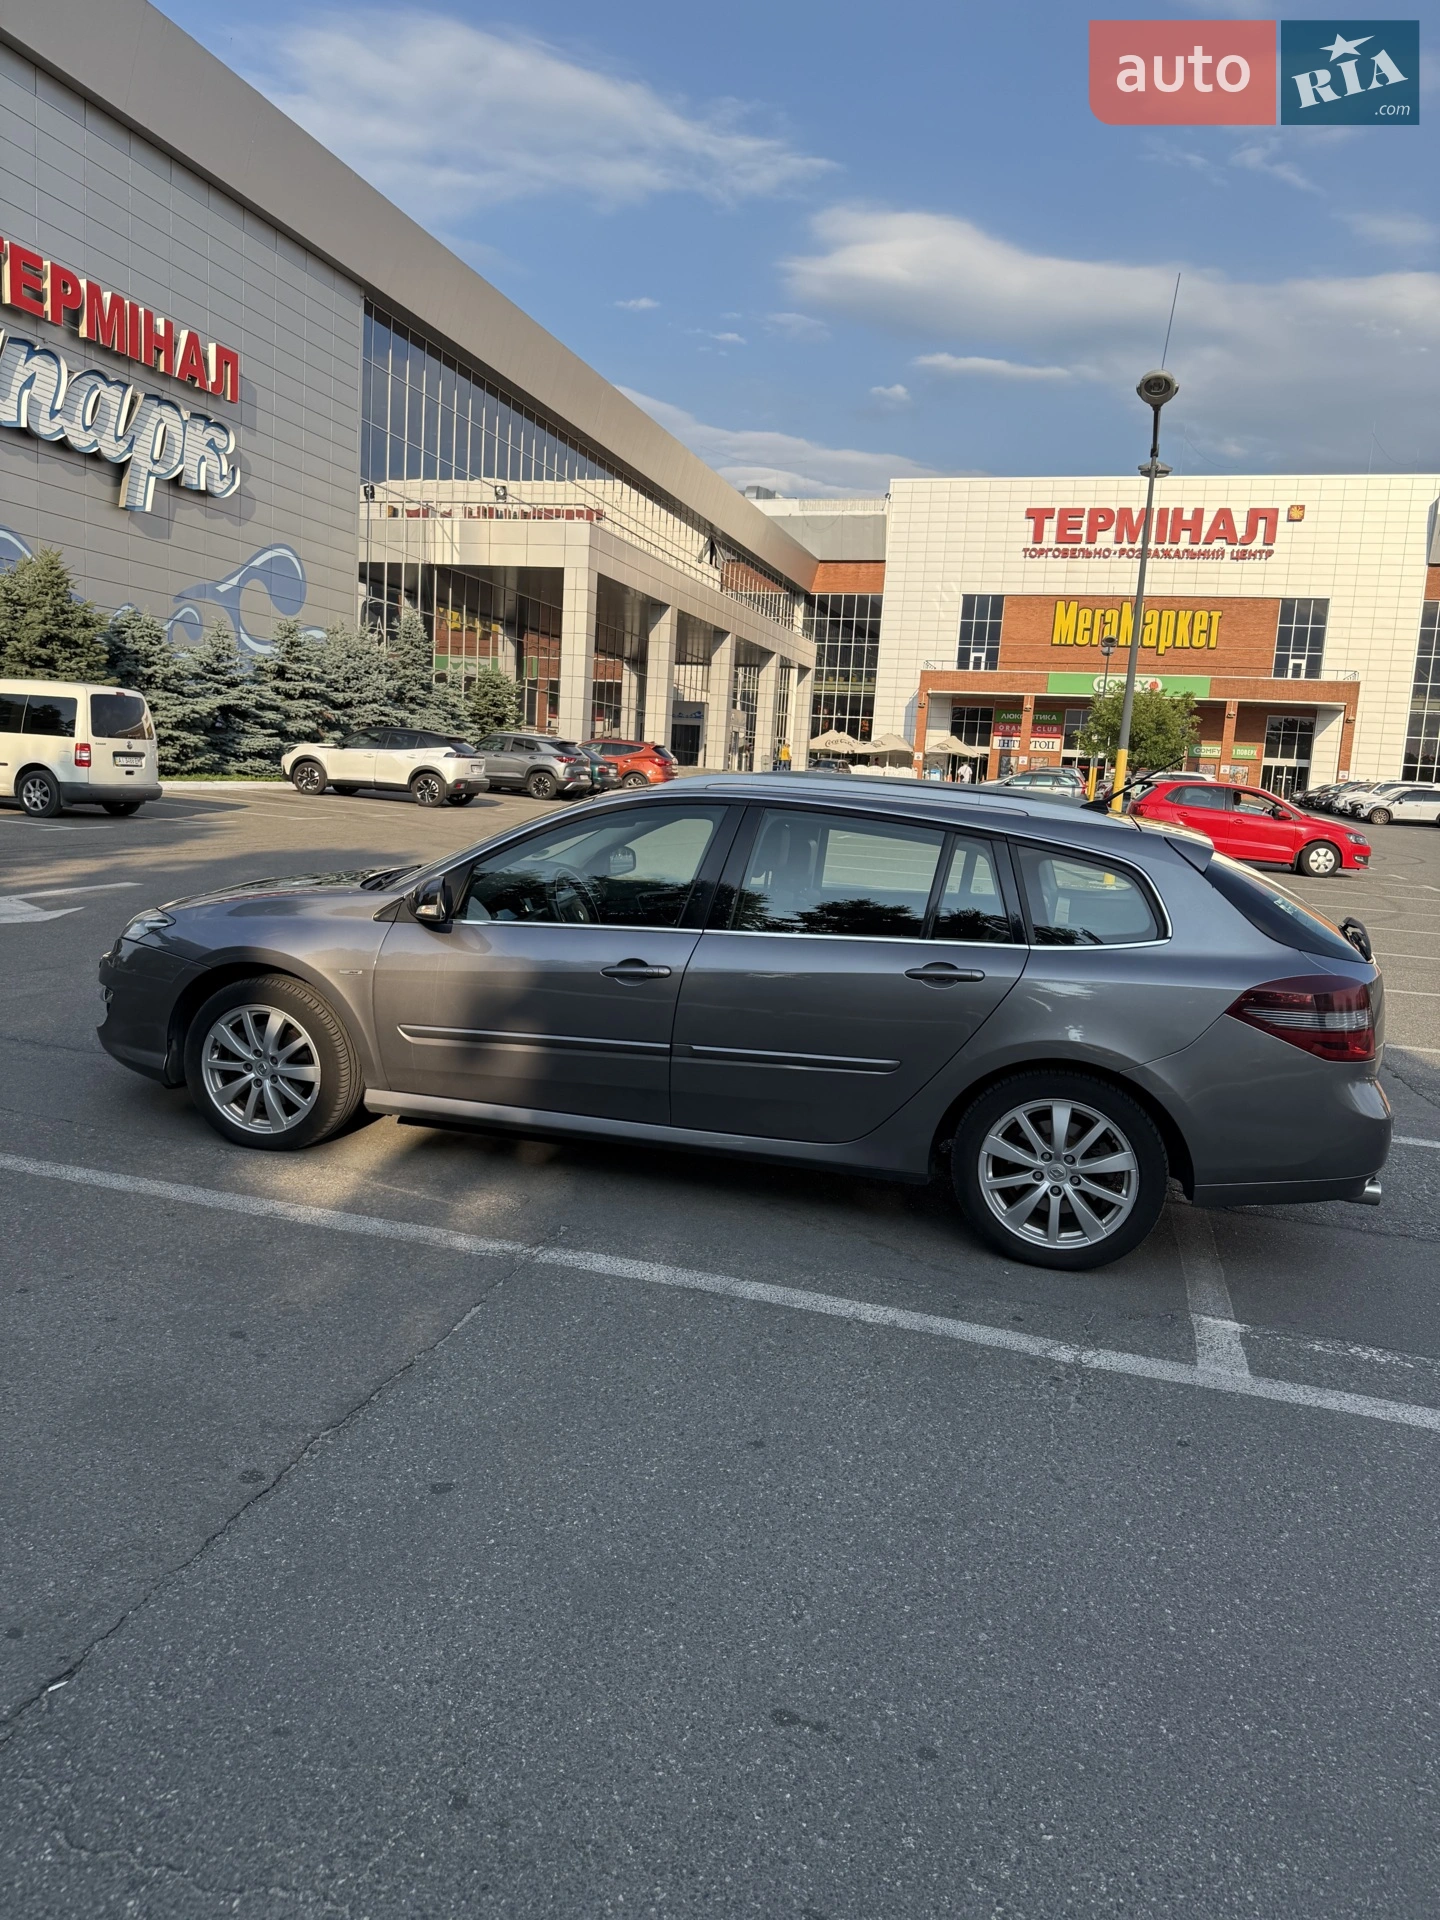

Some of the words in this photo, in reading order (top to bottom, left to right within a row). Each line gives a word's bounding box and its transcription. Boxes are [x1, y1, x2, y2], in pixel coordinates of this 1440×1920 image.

[0, 236, 240, 404] ЕРМІНАЛ
[1025, 507, 1280, 546] ТЕРМІНАЛ
[1230, 548, 1275, 562] ЦЕНТР
[1051, 599, 1223, 656] МегаМаркет
[1097, 678, 1149, 691] COY
[998, 739, 1056, 750] ІНТТОП
[1194, 747, 1221, 755] COMFY
